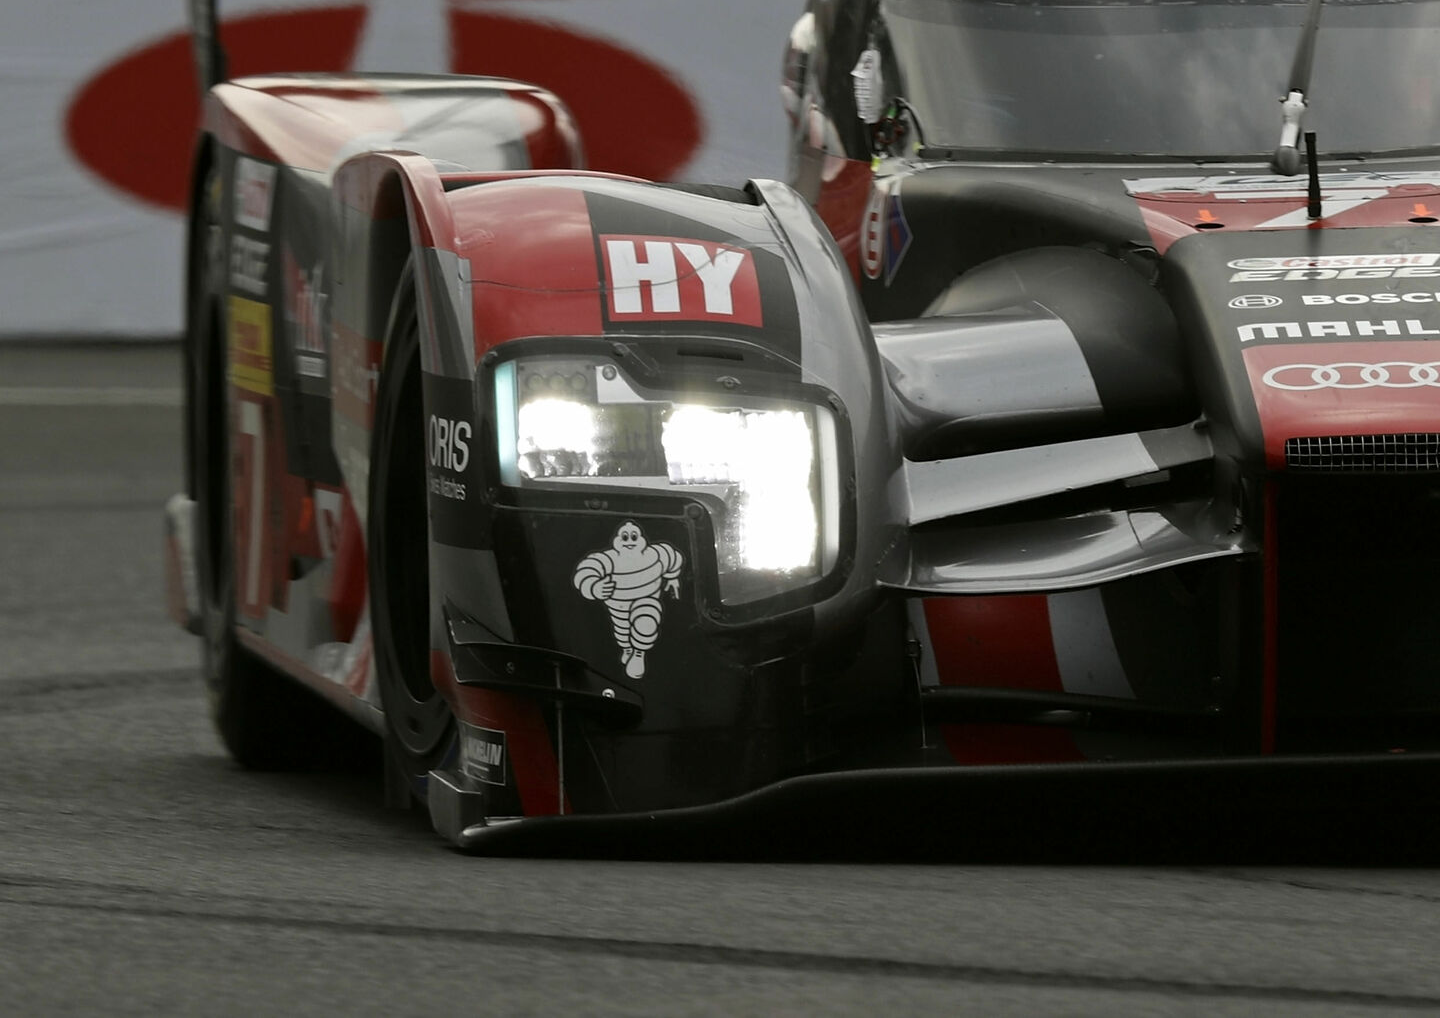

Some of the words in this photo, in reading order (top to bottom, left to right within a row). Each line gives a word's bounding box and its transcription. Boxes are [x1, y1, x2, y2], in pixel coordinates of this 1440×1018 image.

[606, 238, 746, 316] HY
[1281, 254, 1424, 267] Castrol
[429, 413, 472, 473] ORIS
